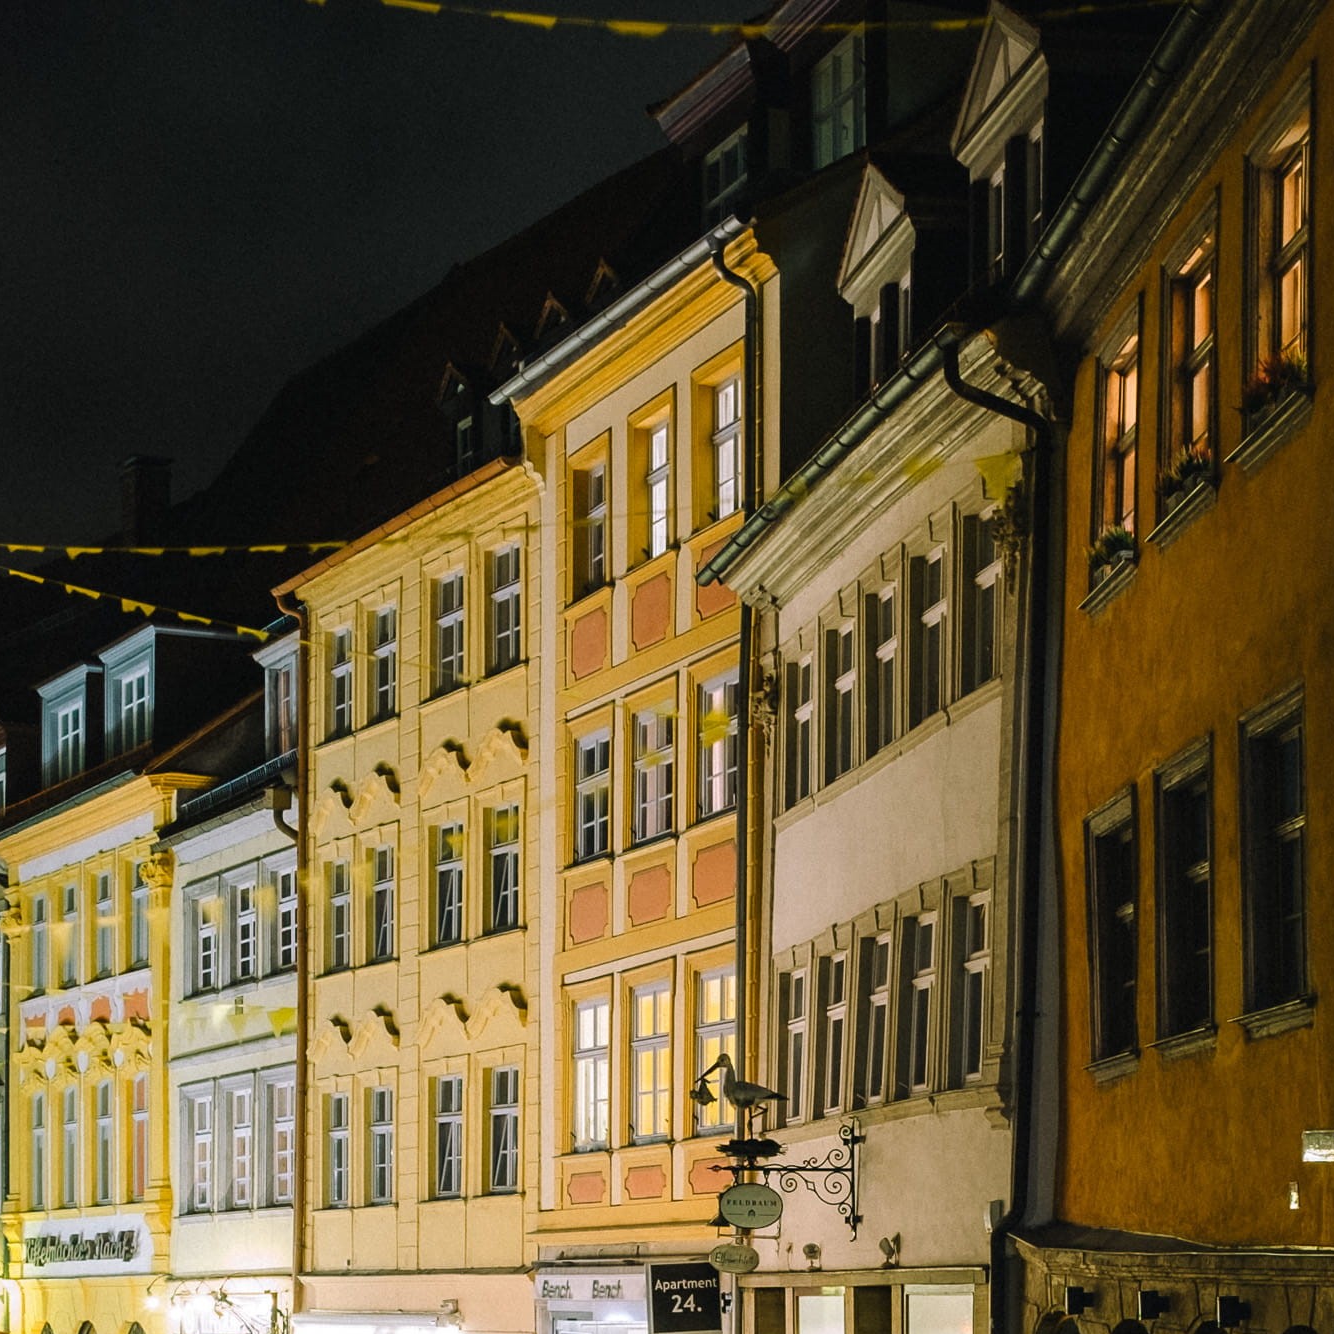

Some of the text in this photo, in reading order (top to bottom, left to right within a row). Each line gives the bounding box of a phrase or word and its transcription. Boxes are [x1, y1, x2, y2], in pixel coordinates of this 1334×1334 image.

[726, 1198, 778, 1208] FELDBAUM
[541, 1279, 624, 1299] Bench Bench
[654, 1277, 718, 1294] Apartment
[670, 1294, 703, 1314] 24.
